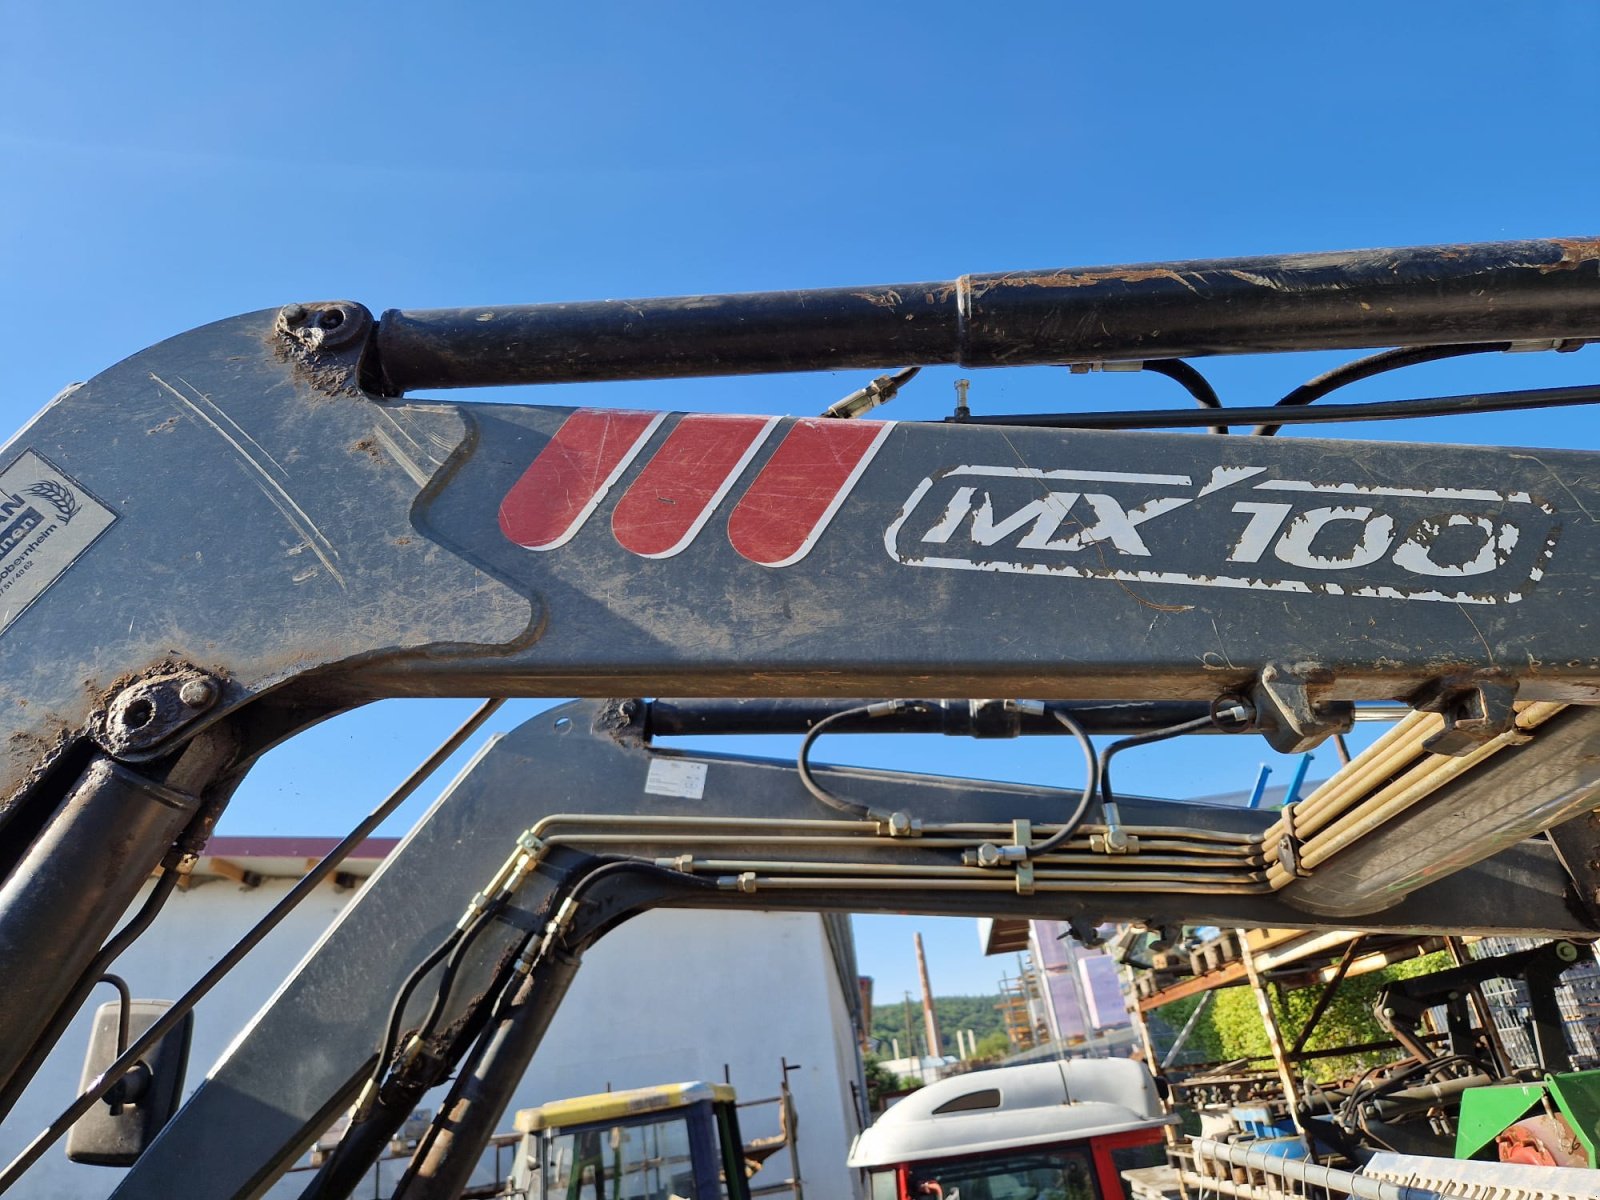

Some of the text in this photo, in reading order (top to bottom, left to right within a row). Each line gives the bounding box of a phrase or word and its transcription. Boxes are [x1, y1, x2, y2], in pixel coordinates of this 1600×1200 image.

[0, 524, 58, 583] obernheim
[921, 486, 1519, 577] MX 100
